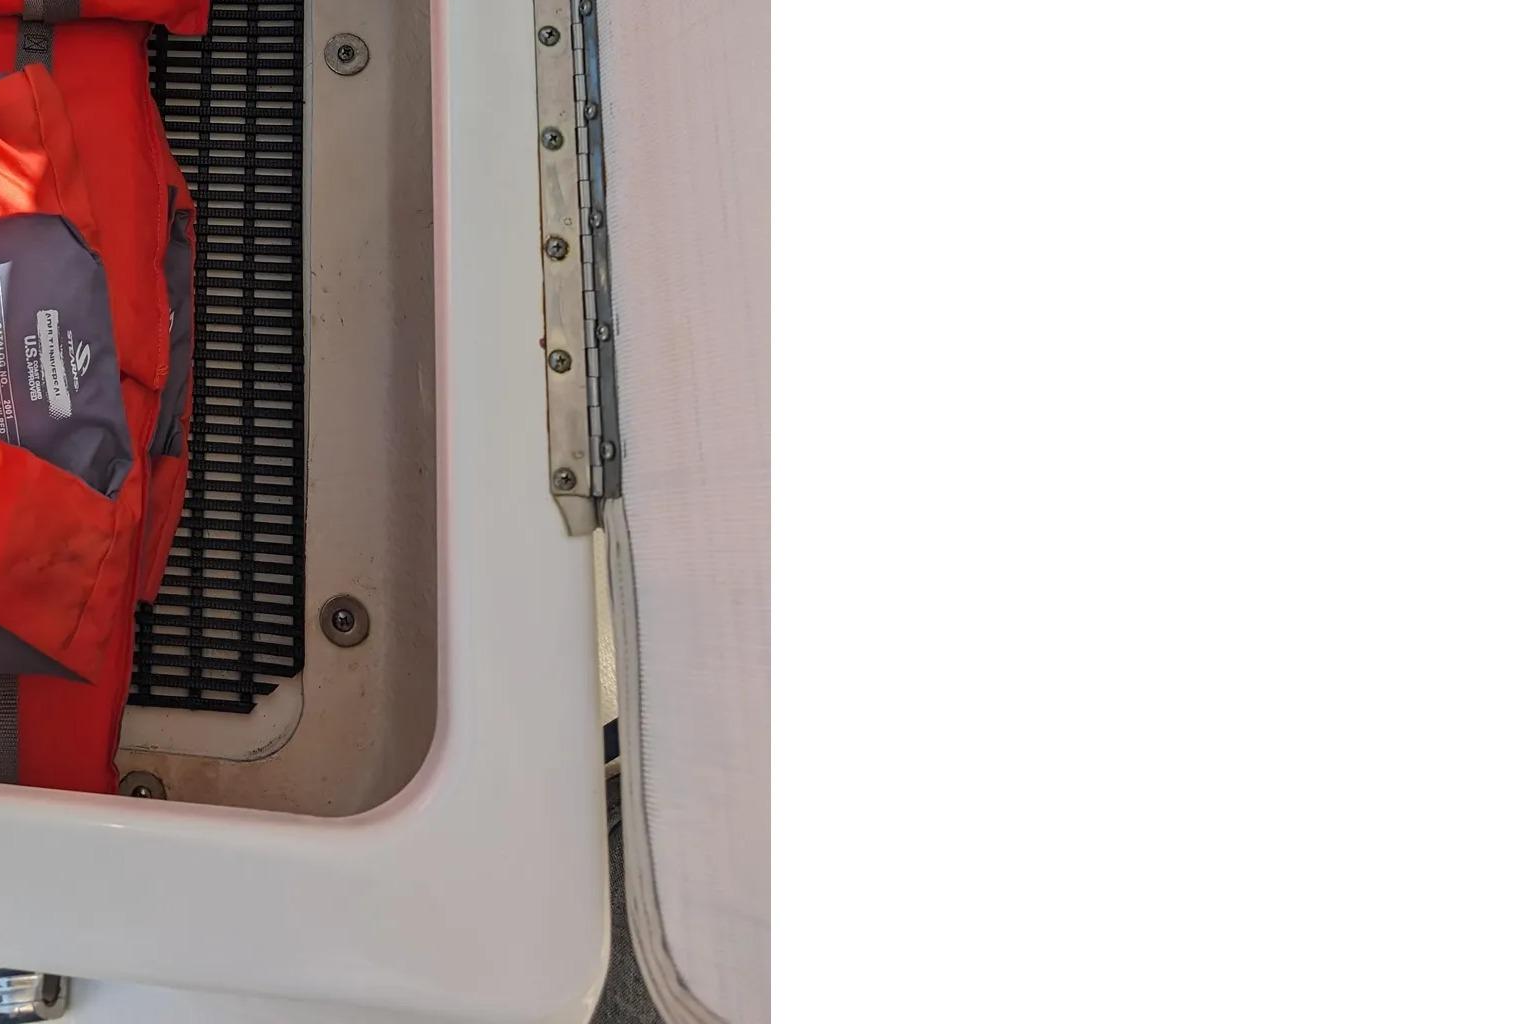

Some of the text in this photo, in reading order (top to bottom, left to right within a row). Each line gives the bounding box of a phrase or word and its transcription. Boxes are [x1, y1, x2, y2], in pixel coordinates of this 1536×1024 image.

[23, 334, 38, 361] U.S.
[32, 360, 40, 379] COAST
[66, 329, 79, 388] STEARNS
[0, 370, 8, 387] NO.
[25, 361, 36, 401] APPROVED
[3, 399, 13, 419] 2001
